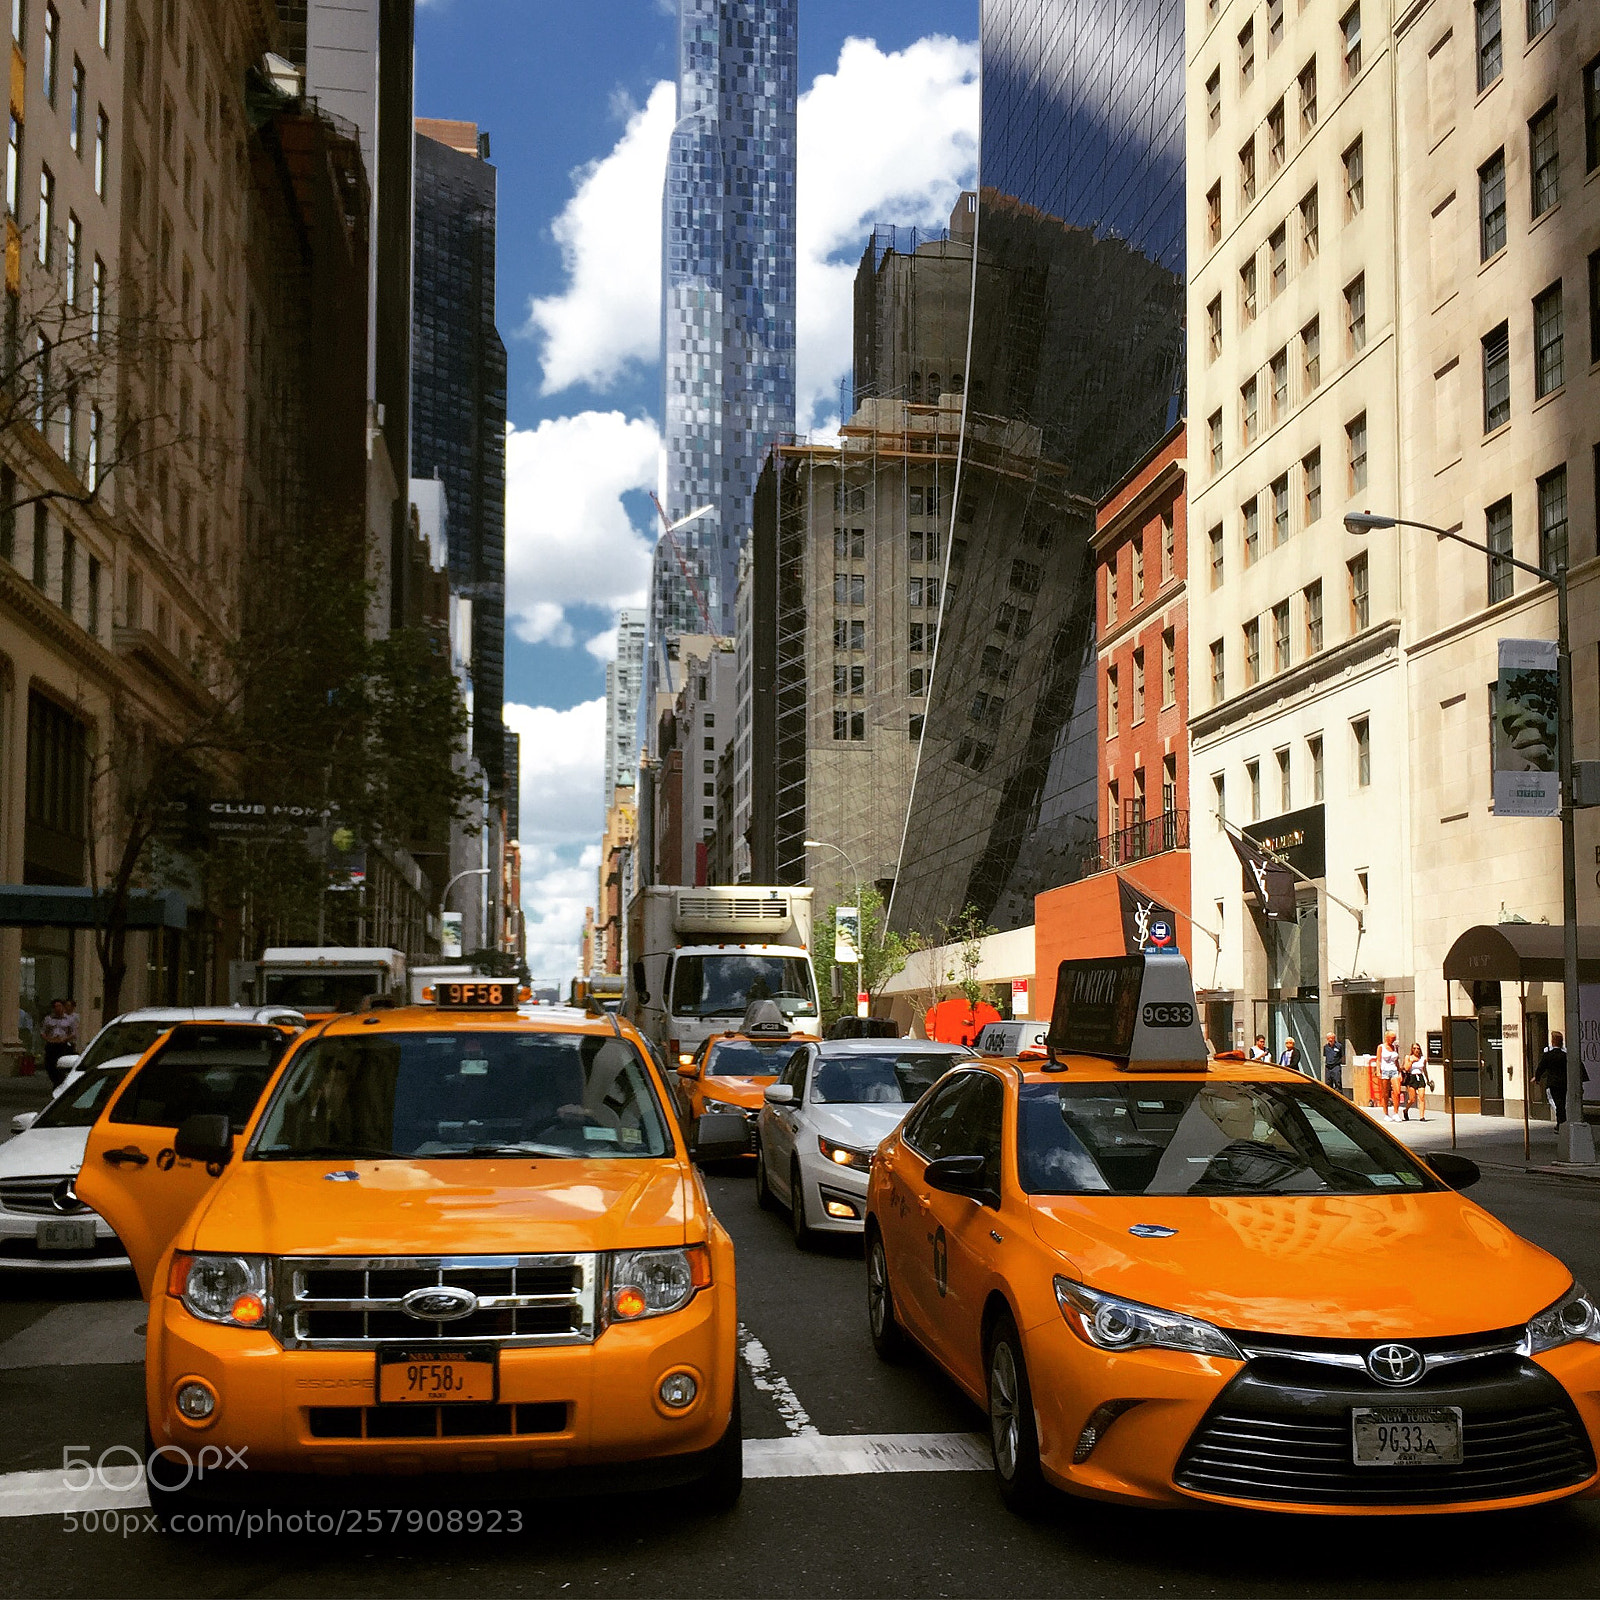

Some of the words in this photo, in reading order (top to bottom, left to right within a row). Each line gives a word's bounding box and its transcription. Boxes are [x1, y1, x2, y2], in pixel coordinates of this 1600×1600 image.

[209, 803, 266, 815] CLUB
[449, 984, 503, 1005] 9F58
[1143, 1006, 1192, 1022] 9G33
[408, 1353, 434, 1361] NEW
[438, 1353, 467, 1361] YORK
[297, 1379, 375, 1389] ESCAPE
[407, 1365, 463, 1391] 9F58J
[1378, 1426, 1438, 1455] 9G33A
